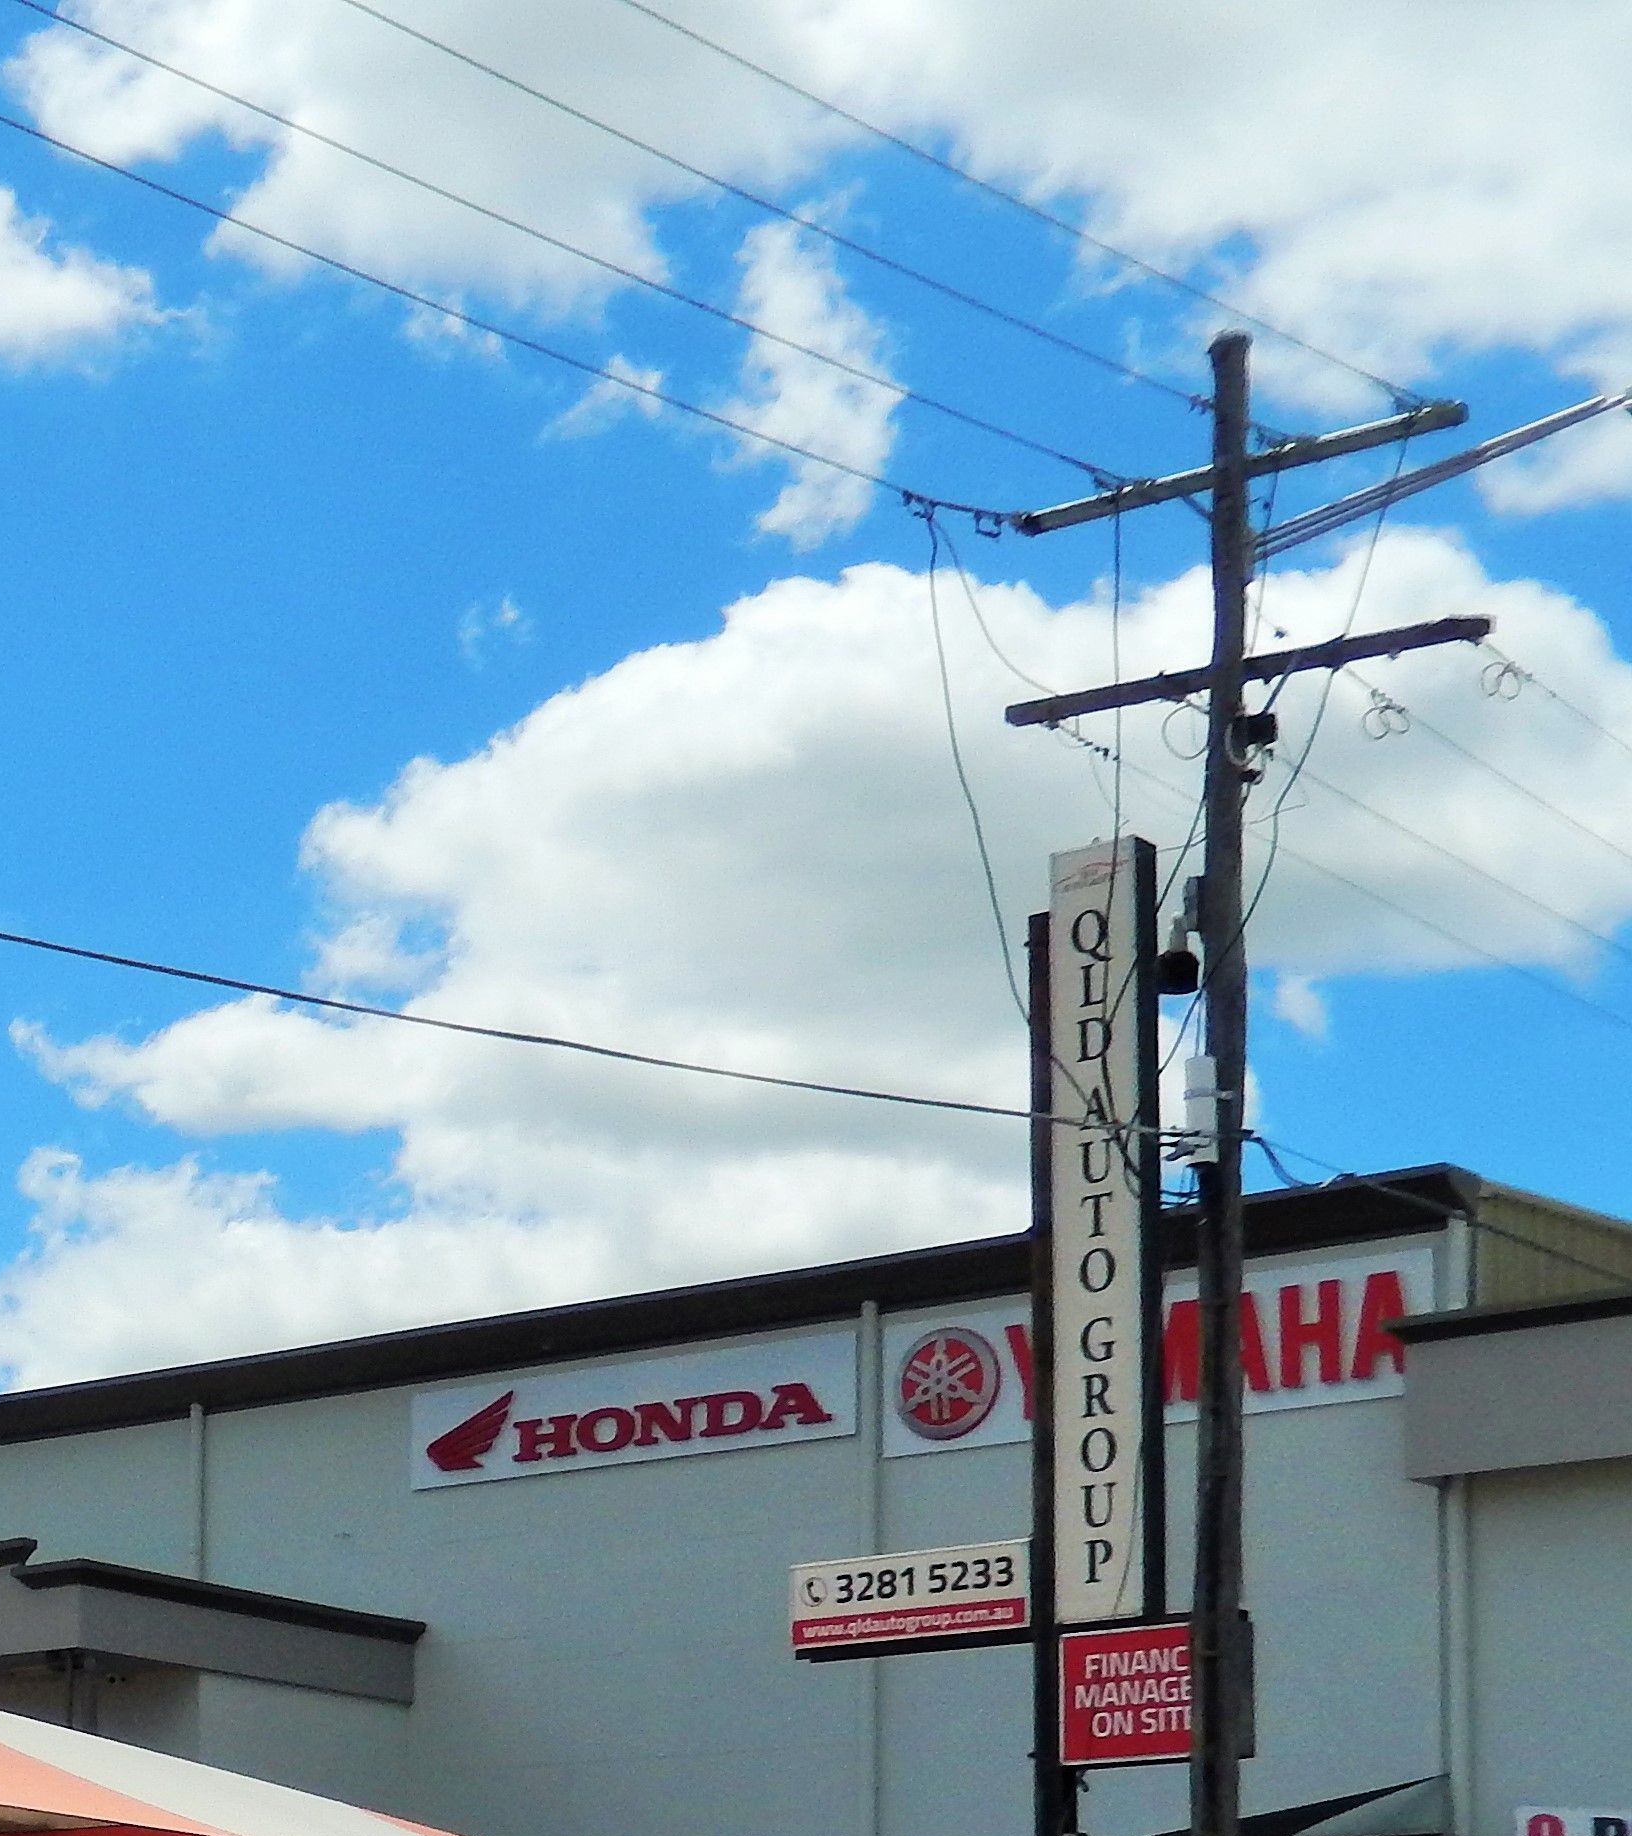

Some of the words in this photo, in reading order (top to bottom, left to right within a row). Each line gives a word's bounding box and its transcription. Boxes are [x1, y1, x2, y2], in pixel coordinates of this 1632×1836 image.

[1070, 908, 1112, 1063] QLD
[1078, 1084, 1119, 1296] AUTO
[1005, 1270, 1406, 1421] MHA
[512, 1382, 832, 1463] HONDA
[1078, 1336, 1119, 1584] GROUP
[836, 1567, 915, 1604] 3281
[928, 1556, 1014, 1594] 5233
[802, 1604, 1015, 1639] www.qldautogroup.com.au
[1074, 1674, 1193, 1710] MANAGE
[1084, 1645, 1190, 1680] FINANC
[1091, 1709, 1134, 1739] ON
